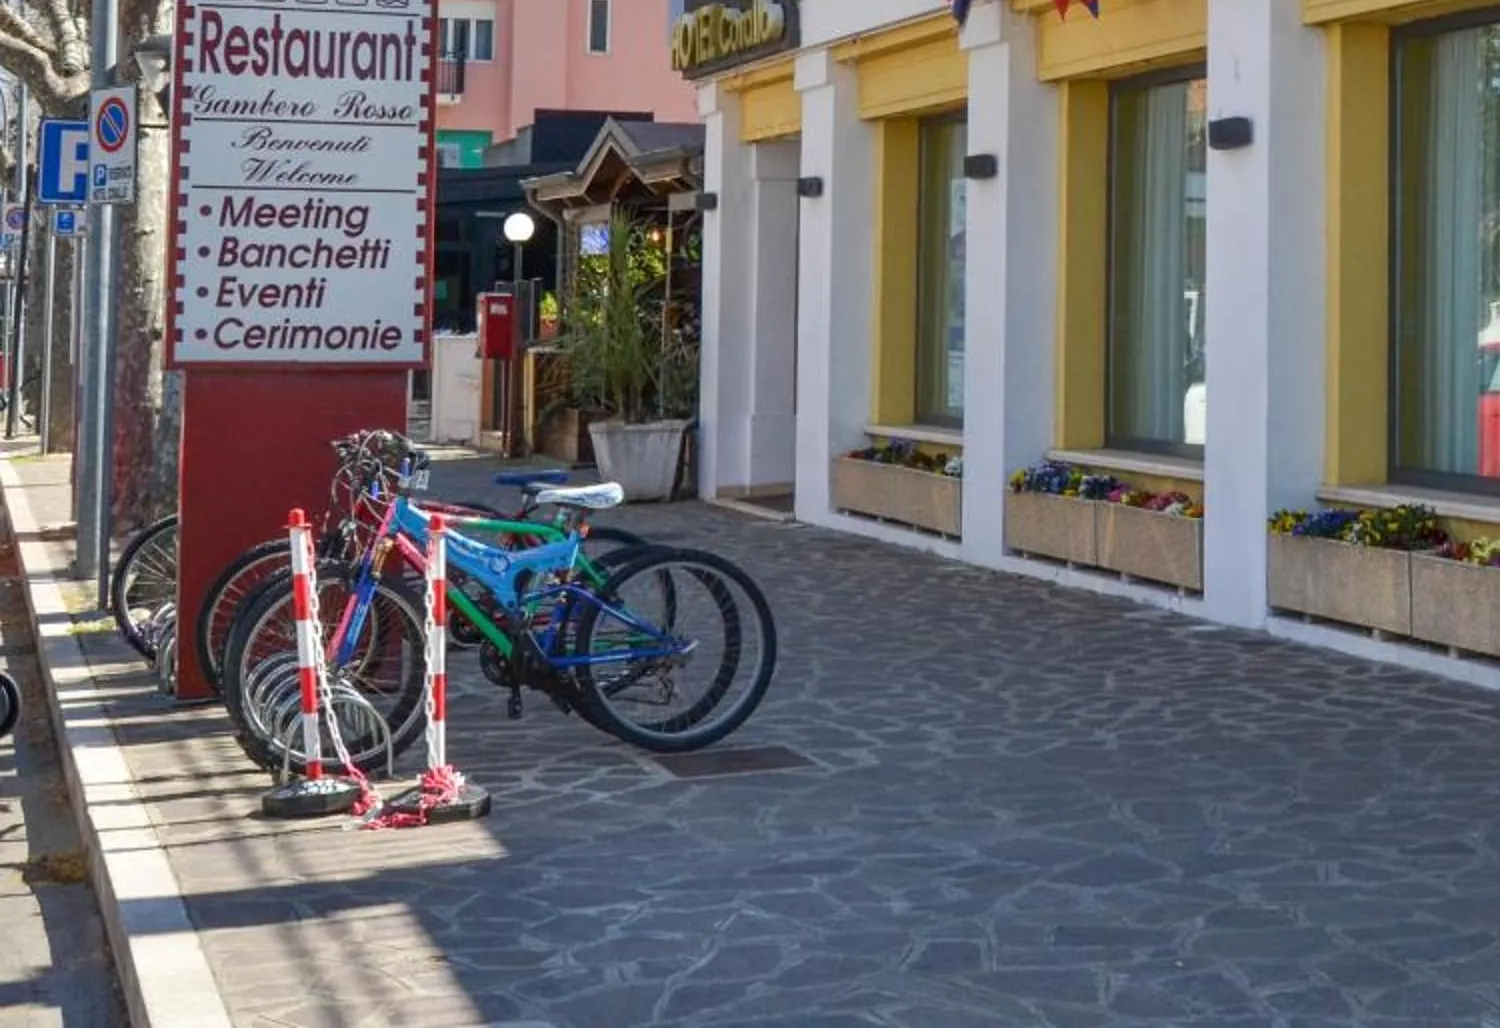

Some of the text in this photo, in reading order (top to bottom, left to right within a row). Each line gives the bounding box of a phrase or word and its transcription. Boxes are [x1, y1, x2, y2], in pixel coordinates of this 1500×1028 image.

[200, 10, 416, 82] Restaurant
[192, 82, 416, 121] Gambero Rosso
[231, 125, 374, 155] Benvenuti
[241, 157, 360, 186] Welcome
[219, 195, 369, 238] Meeting
[217, 235, 392, 270] Banchetti
[214, 274, 327, 310] Eventi
[213, 317, 403, 352] Cerimonie
